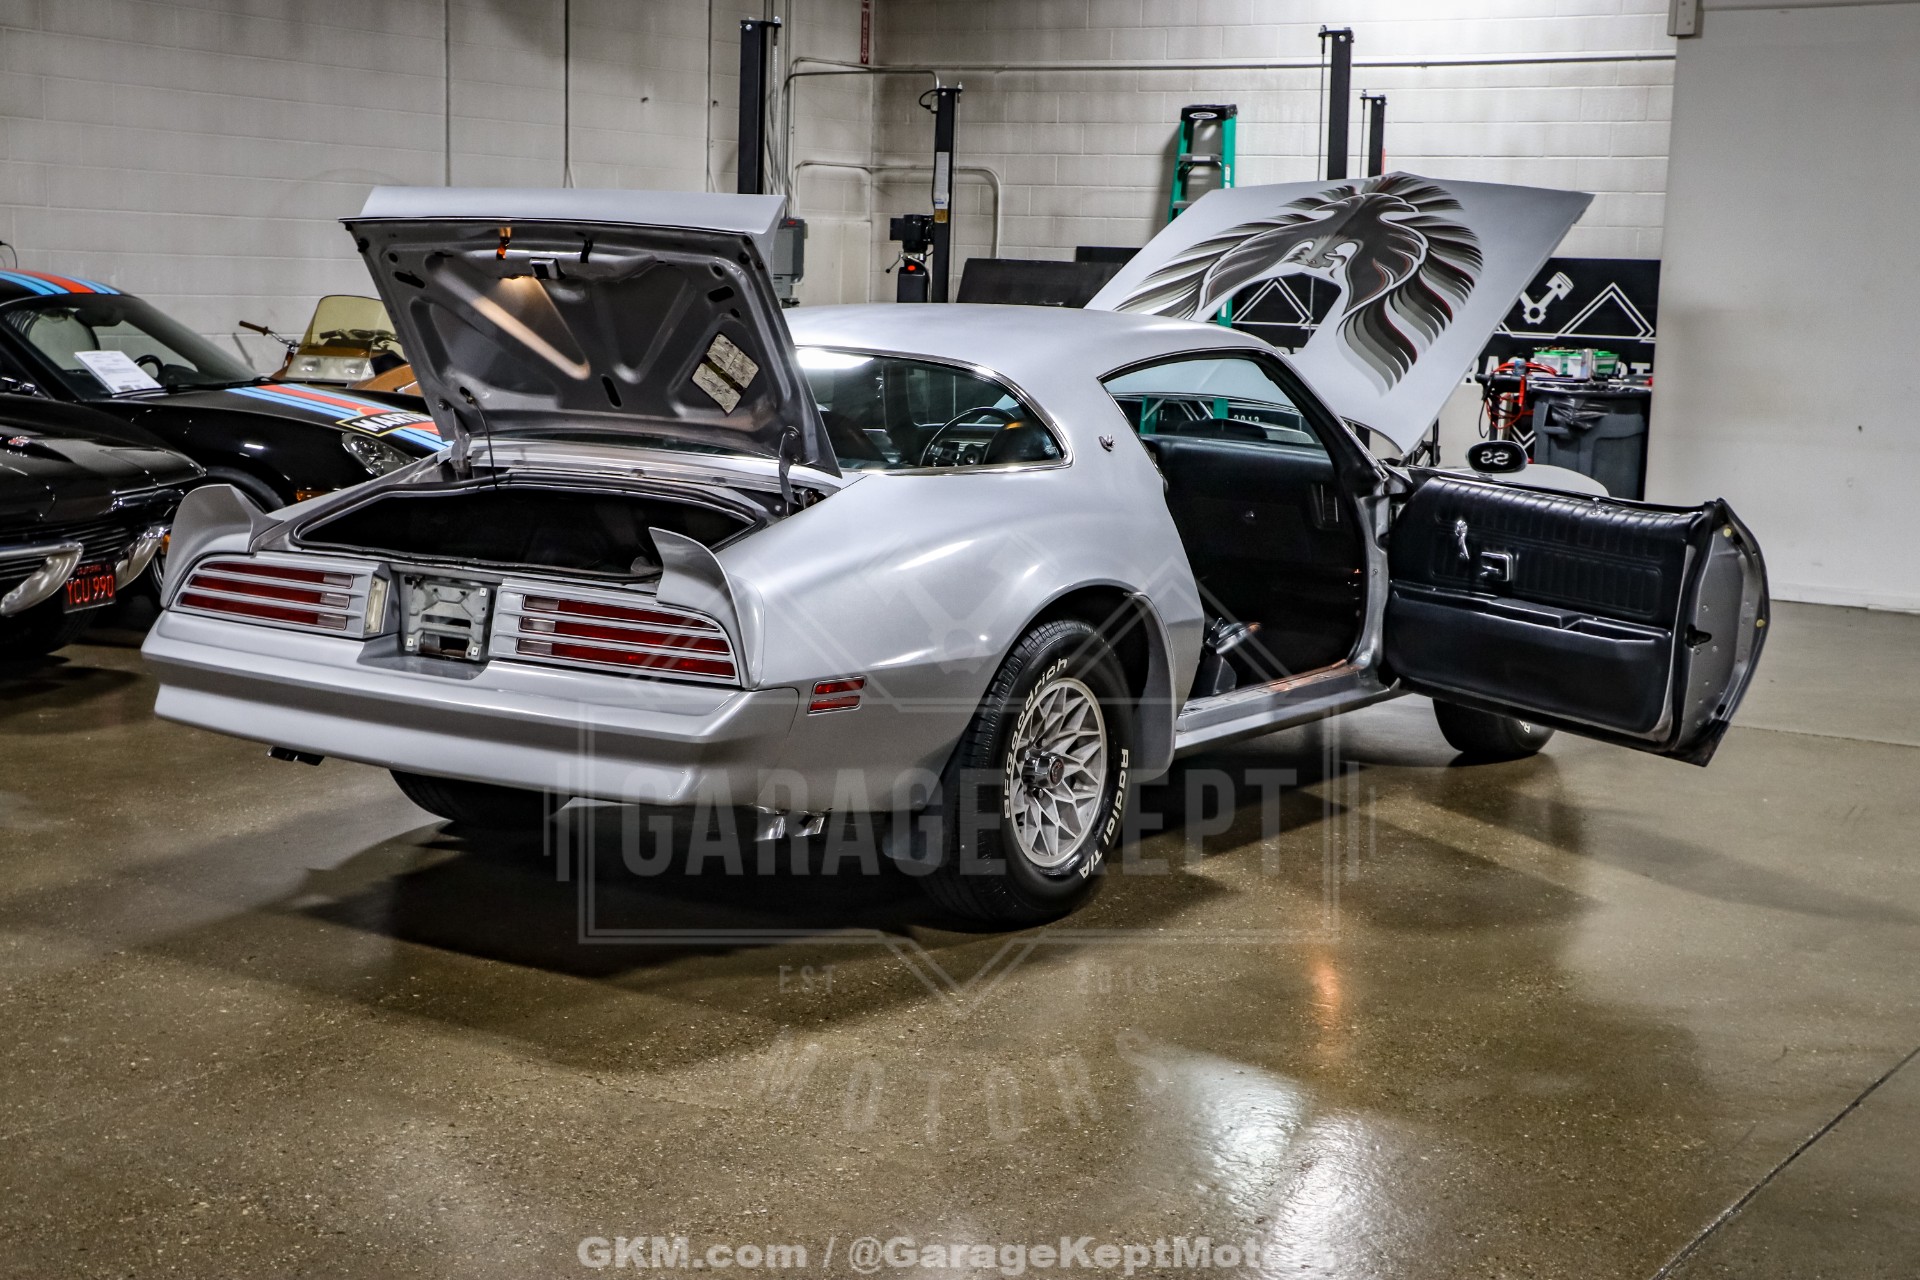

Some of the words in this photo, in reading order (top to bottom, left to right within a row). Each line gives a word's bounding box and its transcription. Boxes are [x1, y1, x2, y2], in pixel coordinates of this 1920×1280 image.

[66, 578, 91, 605] YCU
[93, 574, 114, 600] 990
[1103, 748, 1130, 846] Radial
